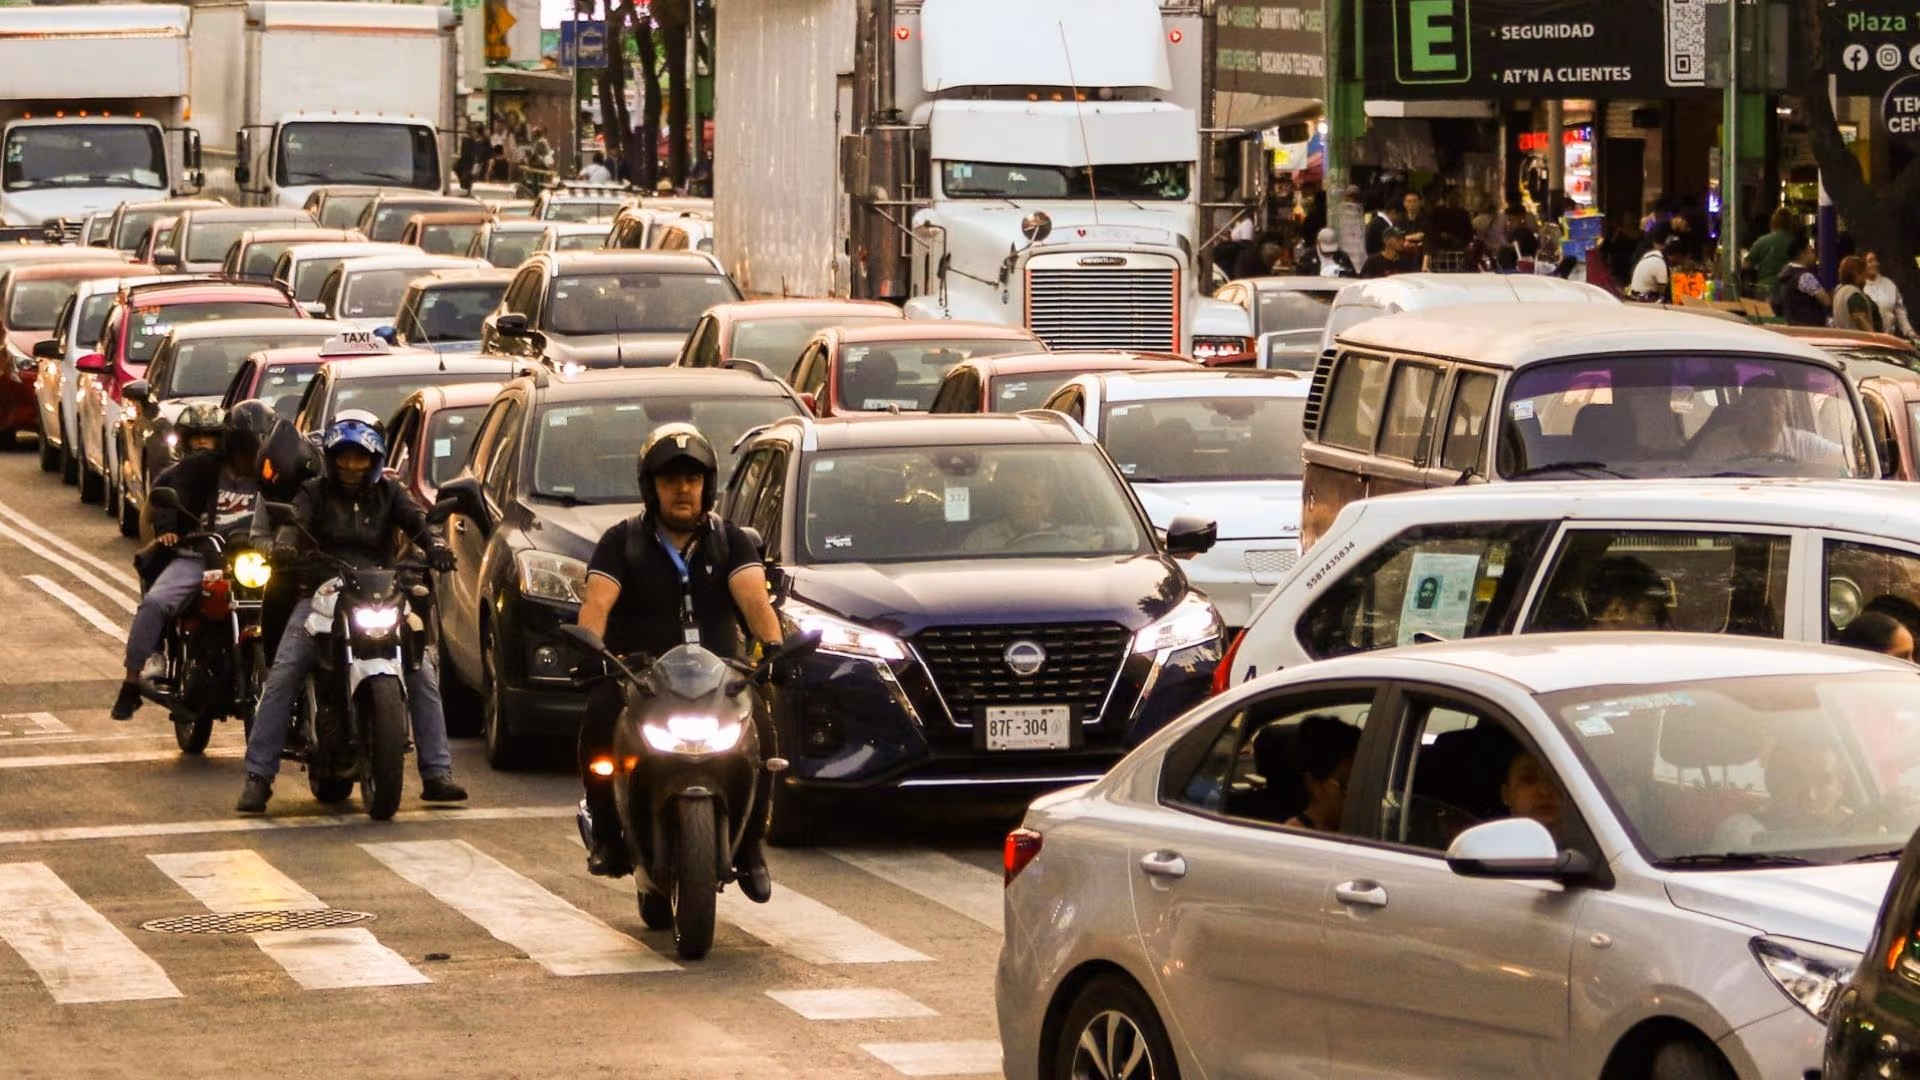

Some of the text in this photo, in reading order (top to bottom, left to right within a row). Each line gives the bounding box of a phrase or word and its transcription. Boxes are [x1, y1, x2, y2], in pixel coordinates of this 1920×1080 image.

[1847, 11, 1907, 32] Plaza
[1410, 0, 1457, 72] E
[1501, 23, 1595, 40] SEGURIDAD
[1542, 68, 1554, 82] A
[1557, 66, 1632, 82] CLIENTES
[341, 332, 370, 343] TAXI
[990, 719, 1048, 737] 87F-304
